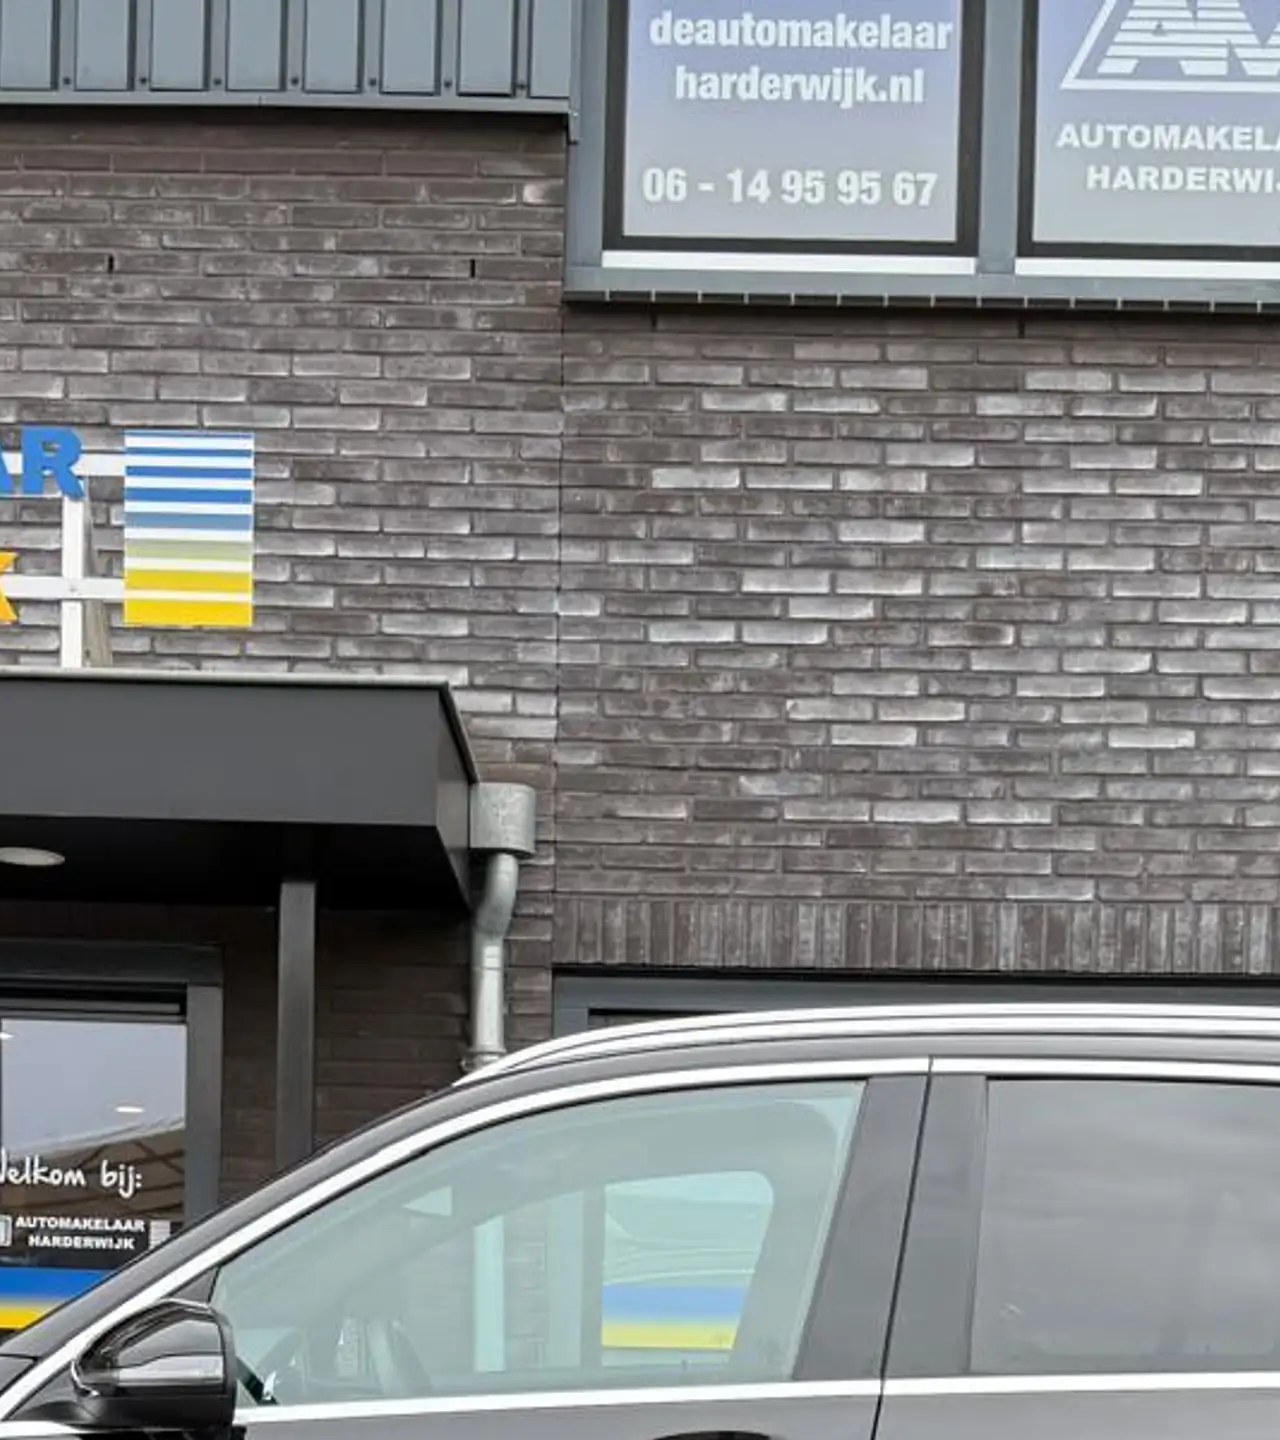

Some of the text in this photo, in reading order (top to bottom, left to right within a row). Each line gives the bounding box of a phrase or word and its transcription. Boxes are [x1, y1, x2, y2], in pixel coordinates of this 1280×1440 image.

[648, 10, 954, 50] deautomakelaar
[675, 65, 925, 110] harderwijk.nl
[642, 167, 938, 207] 06 - 14 95 95 67
[100, 1159, 143, 1199] bij:
[15, 1215, 145, 1233] AUTOMAKELAAR
[28, 1235, 135, 1250] HARDERWIJK
